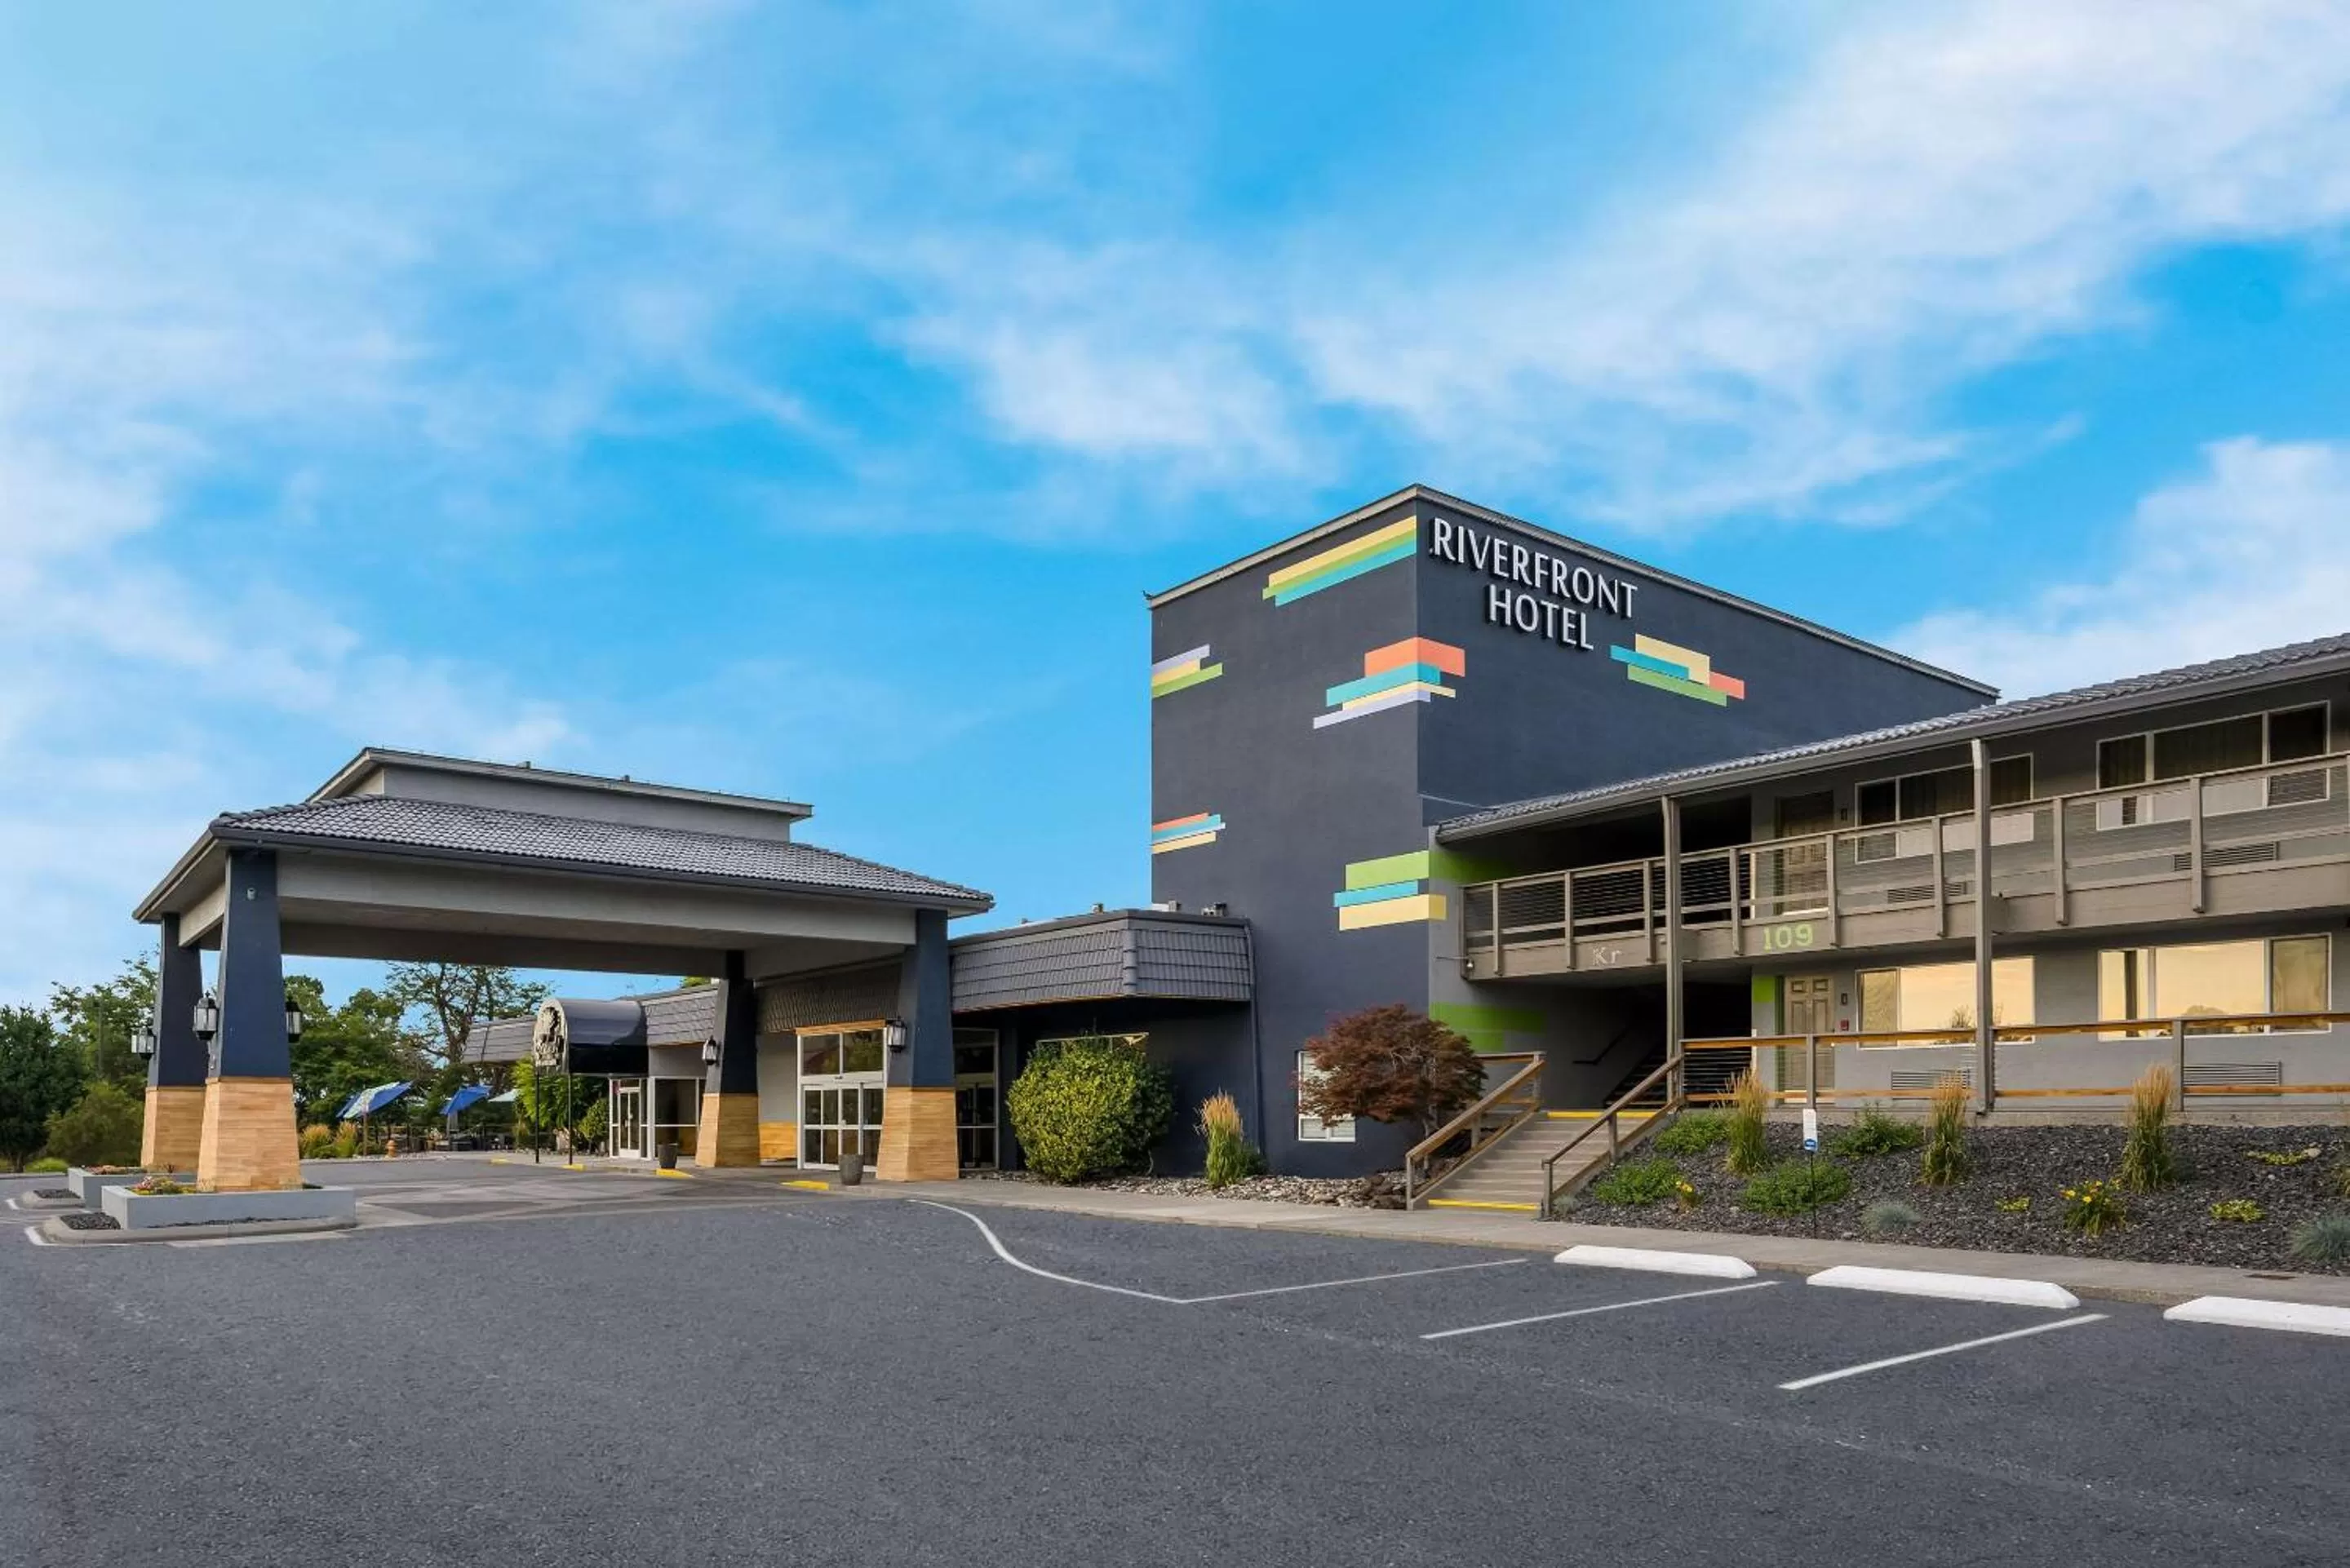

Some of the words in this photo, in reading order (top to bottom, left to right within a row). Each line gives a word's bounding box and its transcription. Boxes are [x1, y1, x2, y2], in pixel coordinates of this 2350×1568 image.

[1433, 517, 1638, 619] RIVERFRONT
[1488, 583, 1594, 651] HOTEL
[1763, 924, 1813, 951] 109
